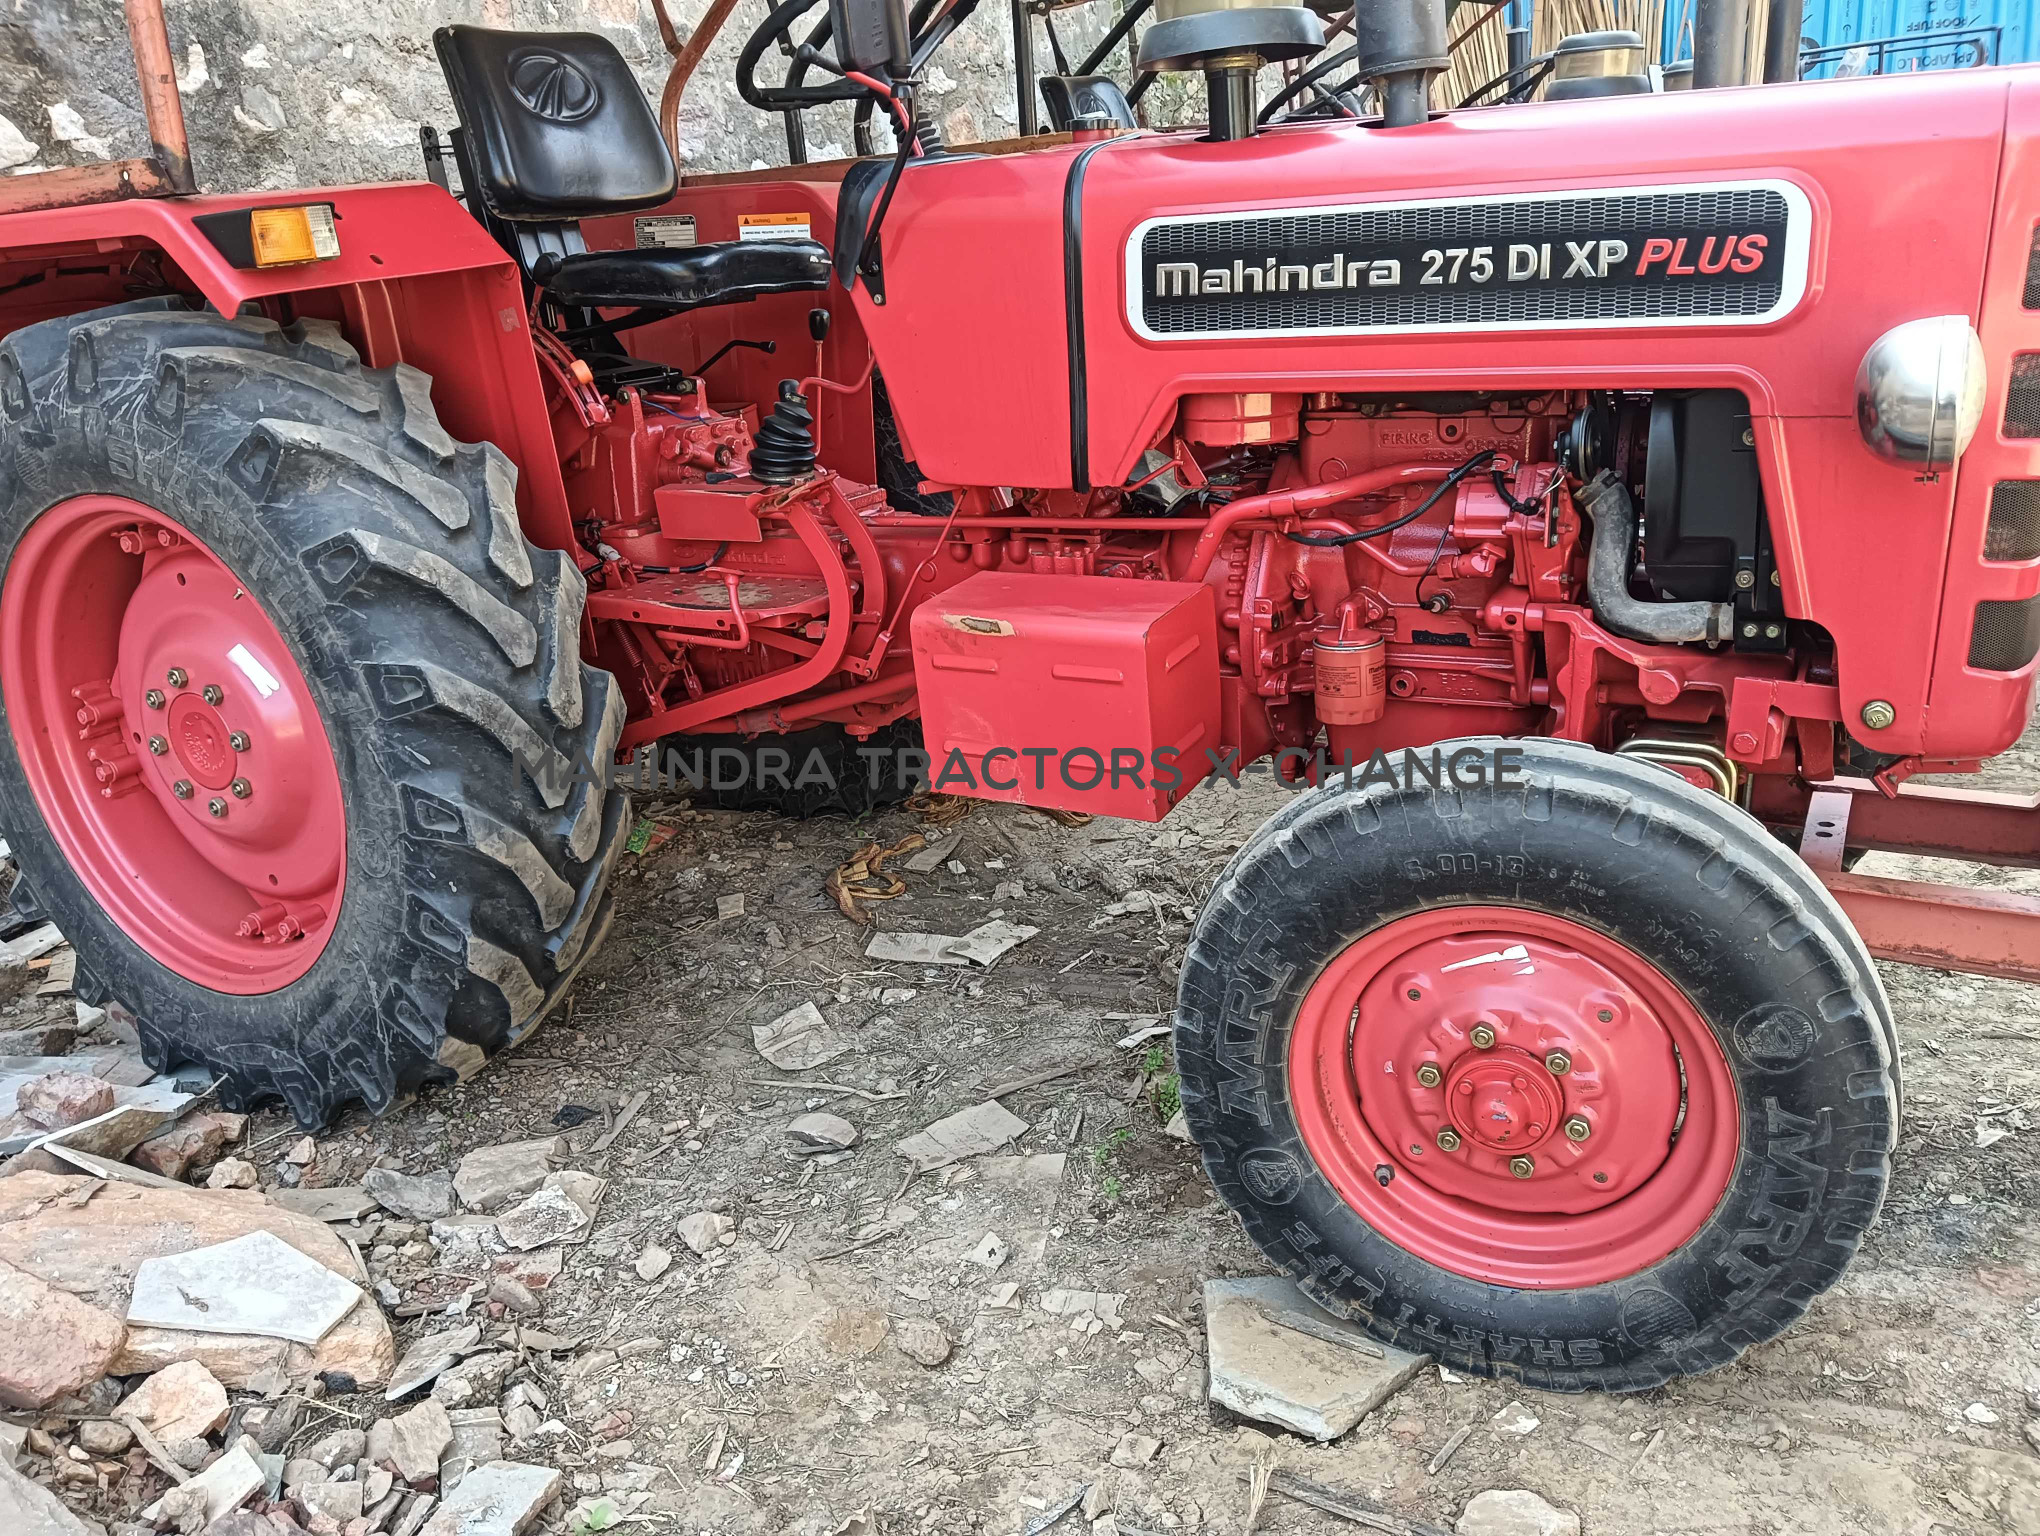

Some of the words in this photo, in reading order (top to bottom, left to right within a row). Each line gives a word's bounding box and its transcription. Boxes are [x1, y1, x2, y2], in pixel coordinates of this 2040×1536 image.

[1156, 254, 1400, 297] Mahindra
[1419, 246, 1494, 285] 275
[1507, 243, 1551, 282] DI
[1562, 239, 1628, 279] XP
[1635, 234, 1768, 277] PLUS
[1382, 431, 1431, 445] FIRING
[1216, 919, 1296, 1127] MRF
[1713, 1096, 1832, 1312] MRF
[1281, 1221, 1384, 1309] LIFE
[1394, 1303, 1604, 1366] SHAKTI
